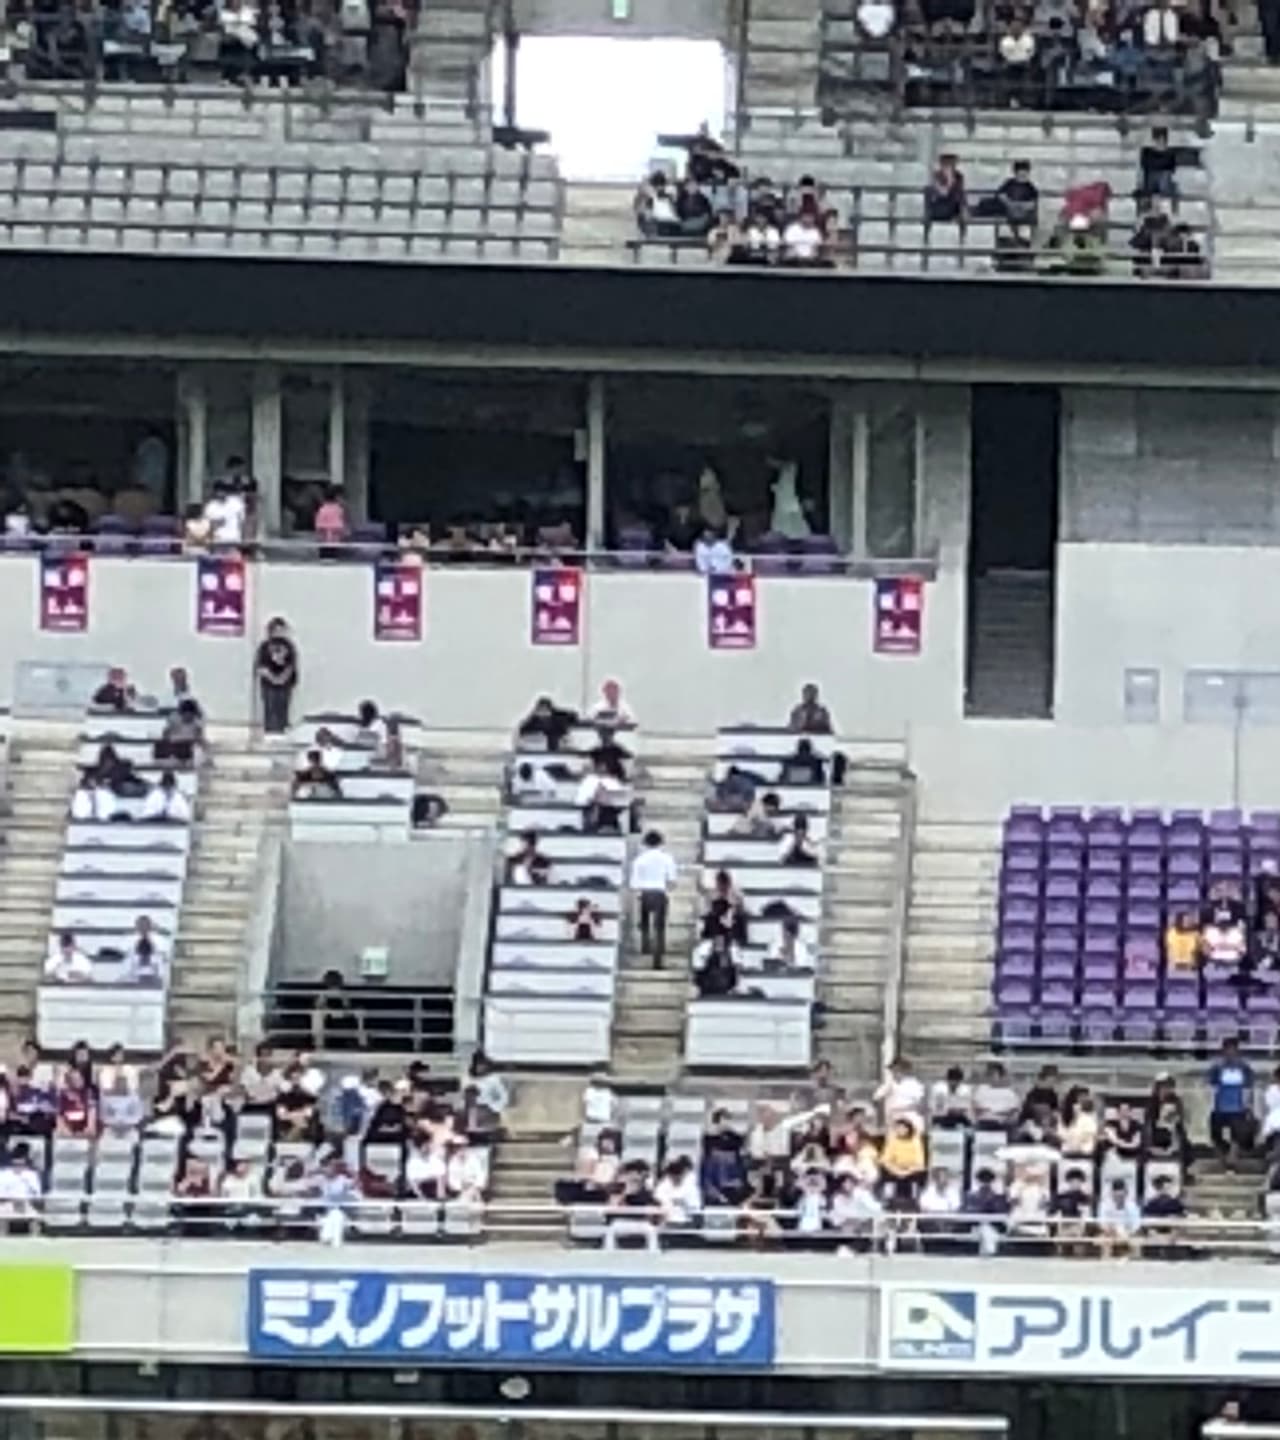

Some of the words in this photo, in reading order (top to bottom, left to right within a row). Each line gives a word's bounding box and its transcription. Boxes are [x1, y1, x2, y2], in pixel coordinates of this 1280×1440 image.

[260, 1279, 762, 1354] ミズノフットサルプラザ
